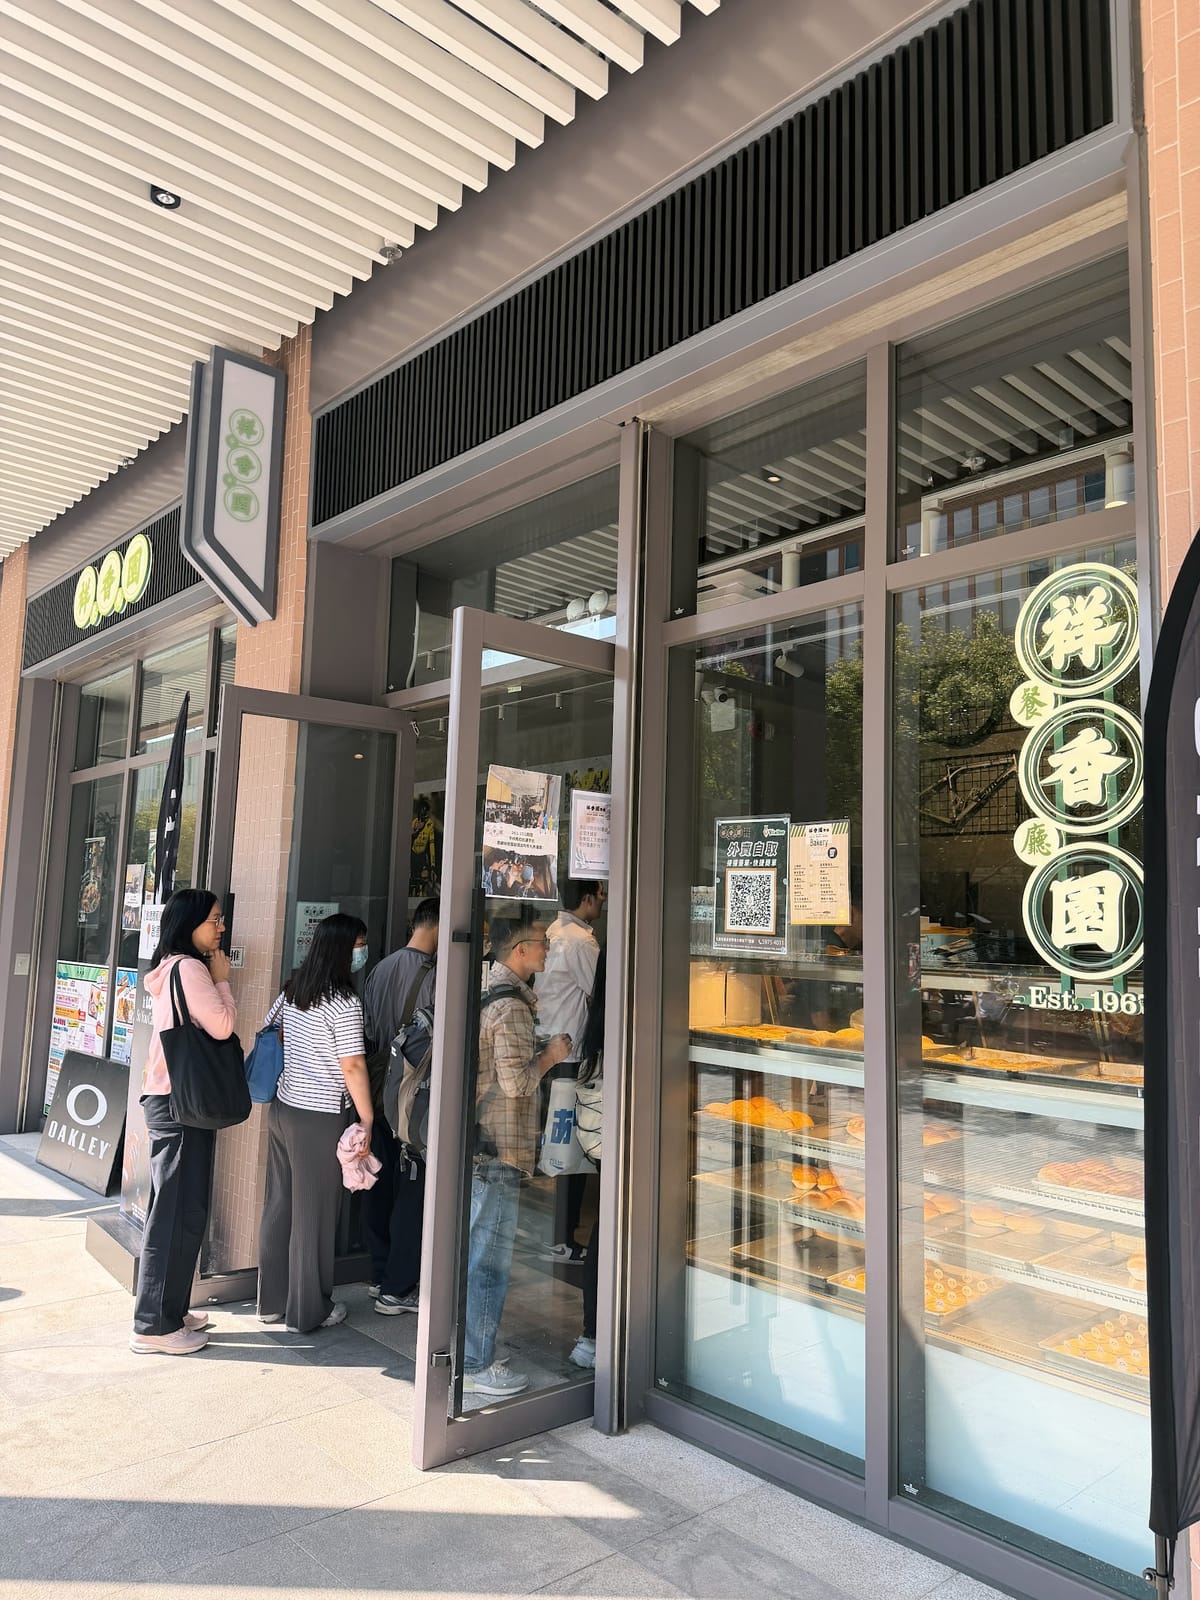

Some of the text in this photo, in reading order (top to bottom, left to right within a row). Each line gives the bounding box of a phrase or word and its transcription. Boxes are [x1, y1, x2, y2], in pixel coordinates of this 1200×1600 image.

[1017, 684, 1052, 857] 餐廳
[1036, 582, 1134, 955] 祥香園
[726, 841, 779, 857] 外賣自取
[810, 838, 829, 847] Bakery
[1028, 985, 1144, 1015] Est. 196
[48, 1120, 110, 1160] OAKLEY
[551, 1108, 576, 1145] あ
